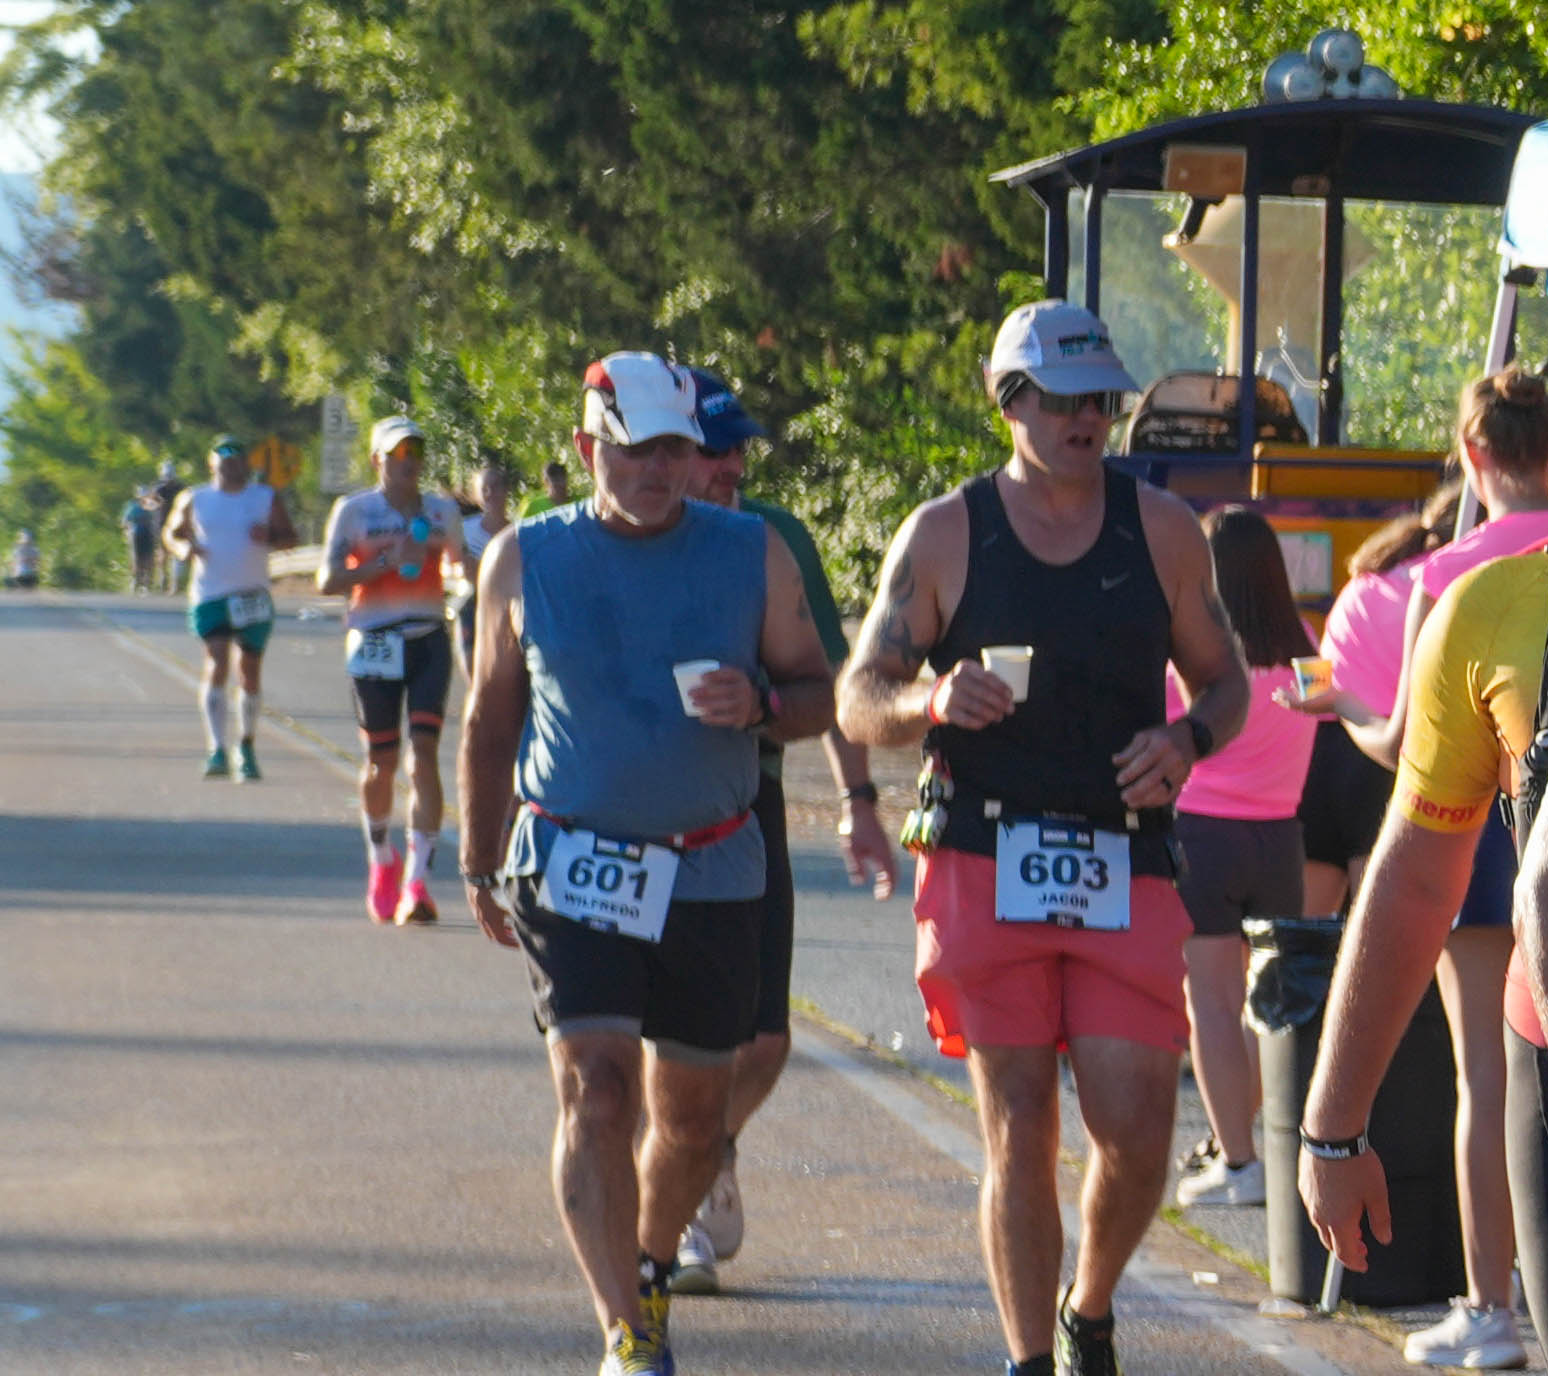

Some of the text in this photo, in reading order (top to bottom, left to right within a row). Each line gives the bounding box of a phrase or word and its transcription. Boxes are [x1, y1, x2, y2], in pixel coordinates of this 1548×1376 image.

[567, 856, 649, 902] 601
[1020, 853, 1109, 892] 603
[563, 890, 641, 921] WILFREDO
[1038, 892, 1089, 909] JACOB
